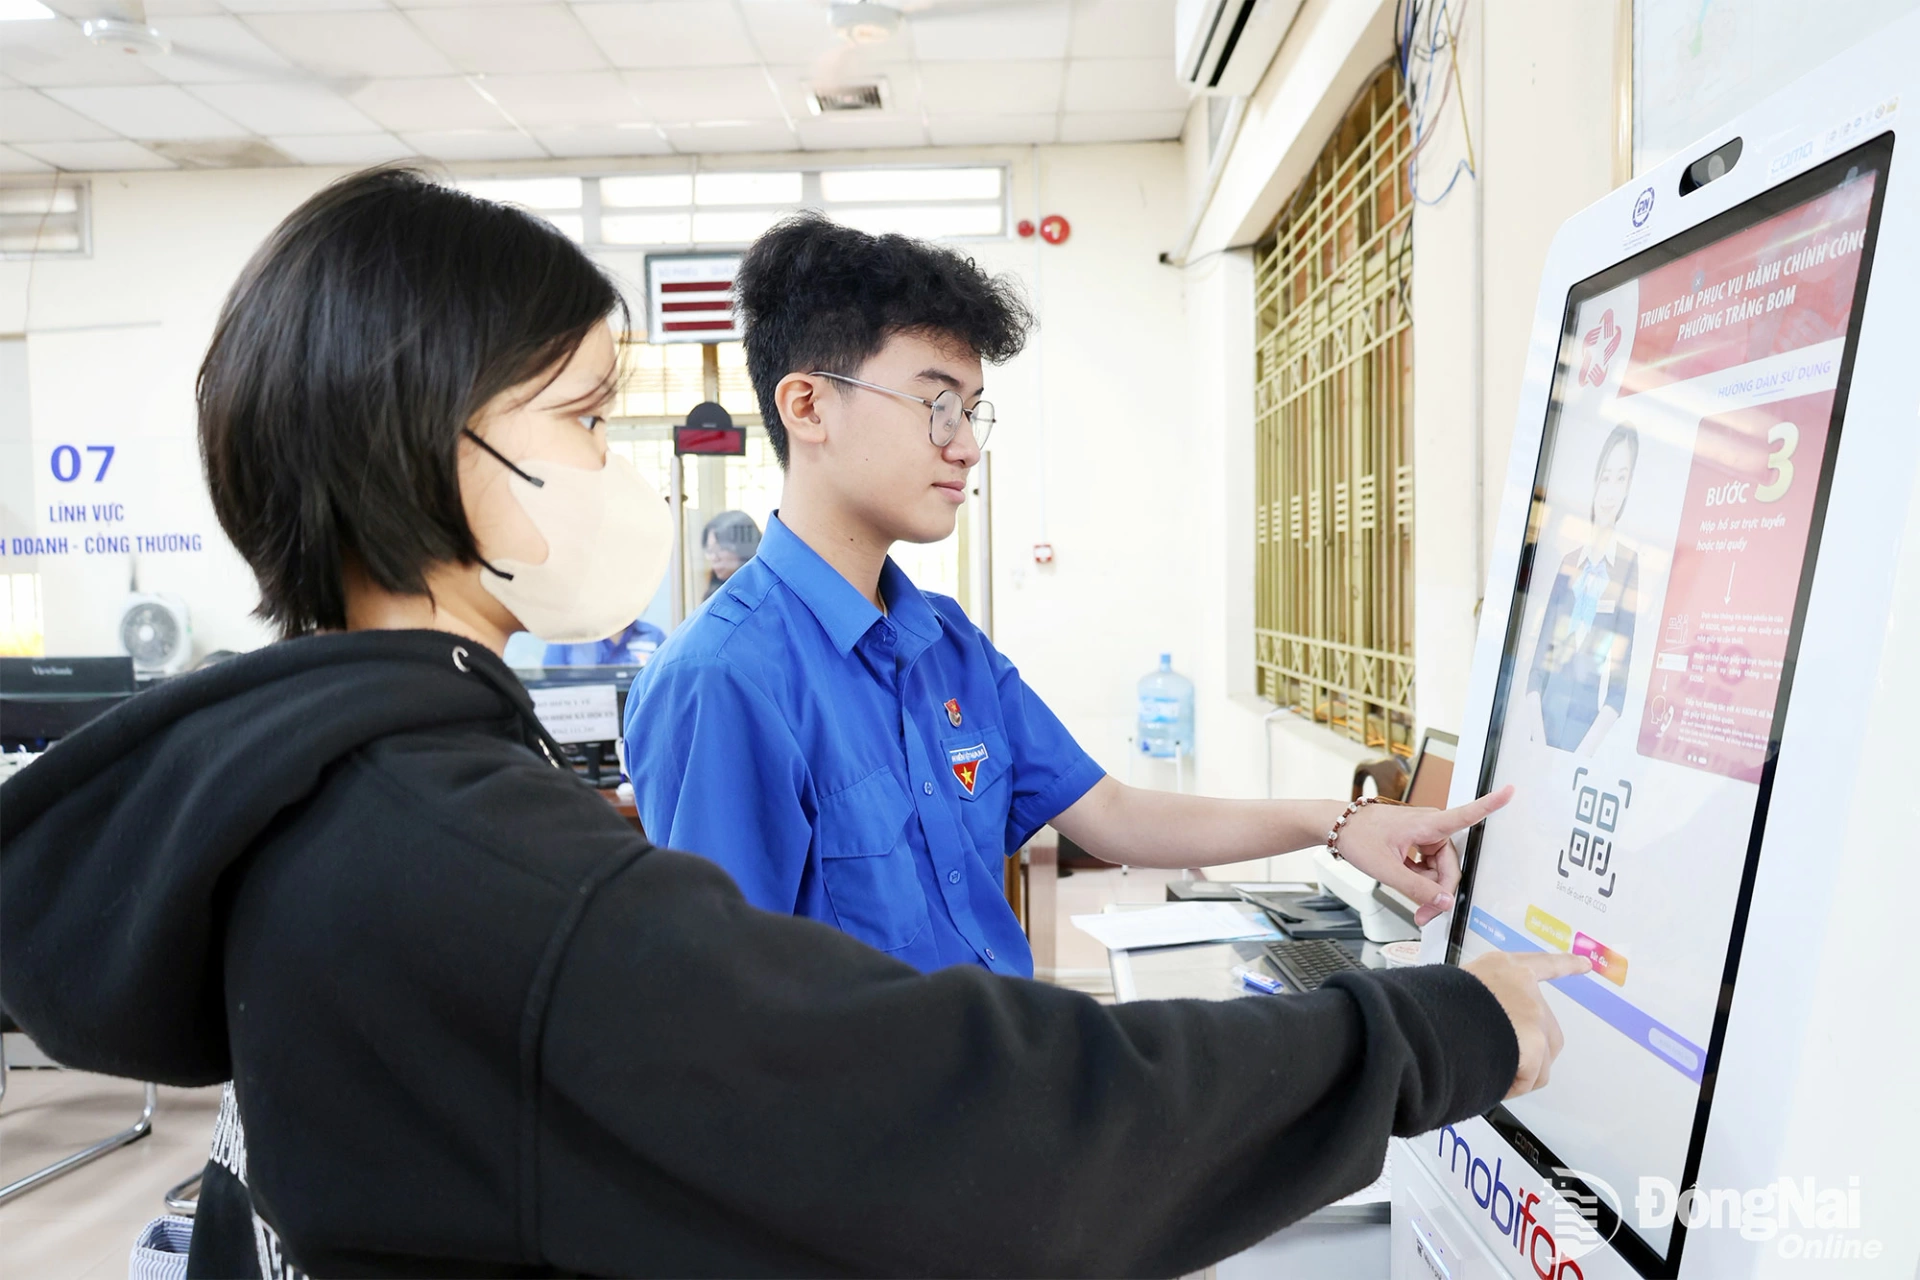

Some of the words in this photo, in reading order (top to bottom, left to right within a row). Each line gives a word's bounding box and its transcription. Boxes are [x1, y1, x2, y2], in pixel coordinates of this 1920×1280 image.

[1640, 303, 1671, 329] TRUNG
[1673, 294, 1694, 317] TÂM
[1696, 281, 1726, 308] PHỤC
[1727, 275, 1743, 299] VỤ
[1745, 260, 1781, 290] HÀNH
[1783, 245, 1828, 276] CHÍNH
[1677, 310, 1723, 341] PHƯỜNG
[1766, 285, 1796, 312] BOM
[50, 445, 115, 483] 07
[1755, 422, 1799, 503] 3
[1705, 480, 1750, 506] BƯỚC
[92, 503, 124, 526] VỰC
[13, 537, 69, 556] DOANH
[85, 532, 130, 555] CÔNG
[136, 533, 202, 553] THƯƠNG
